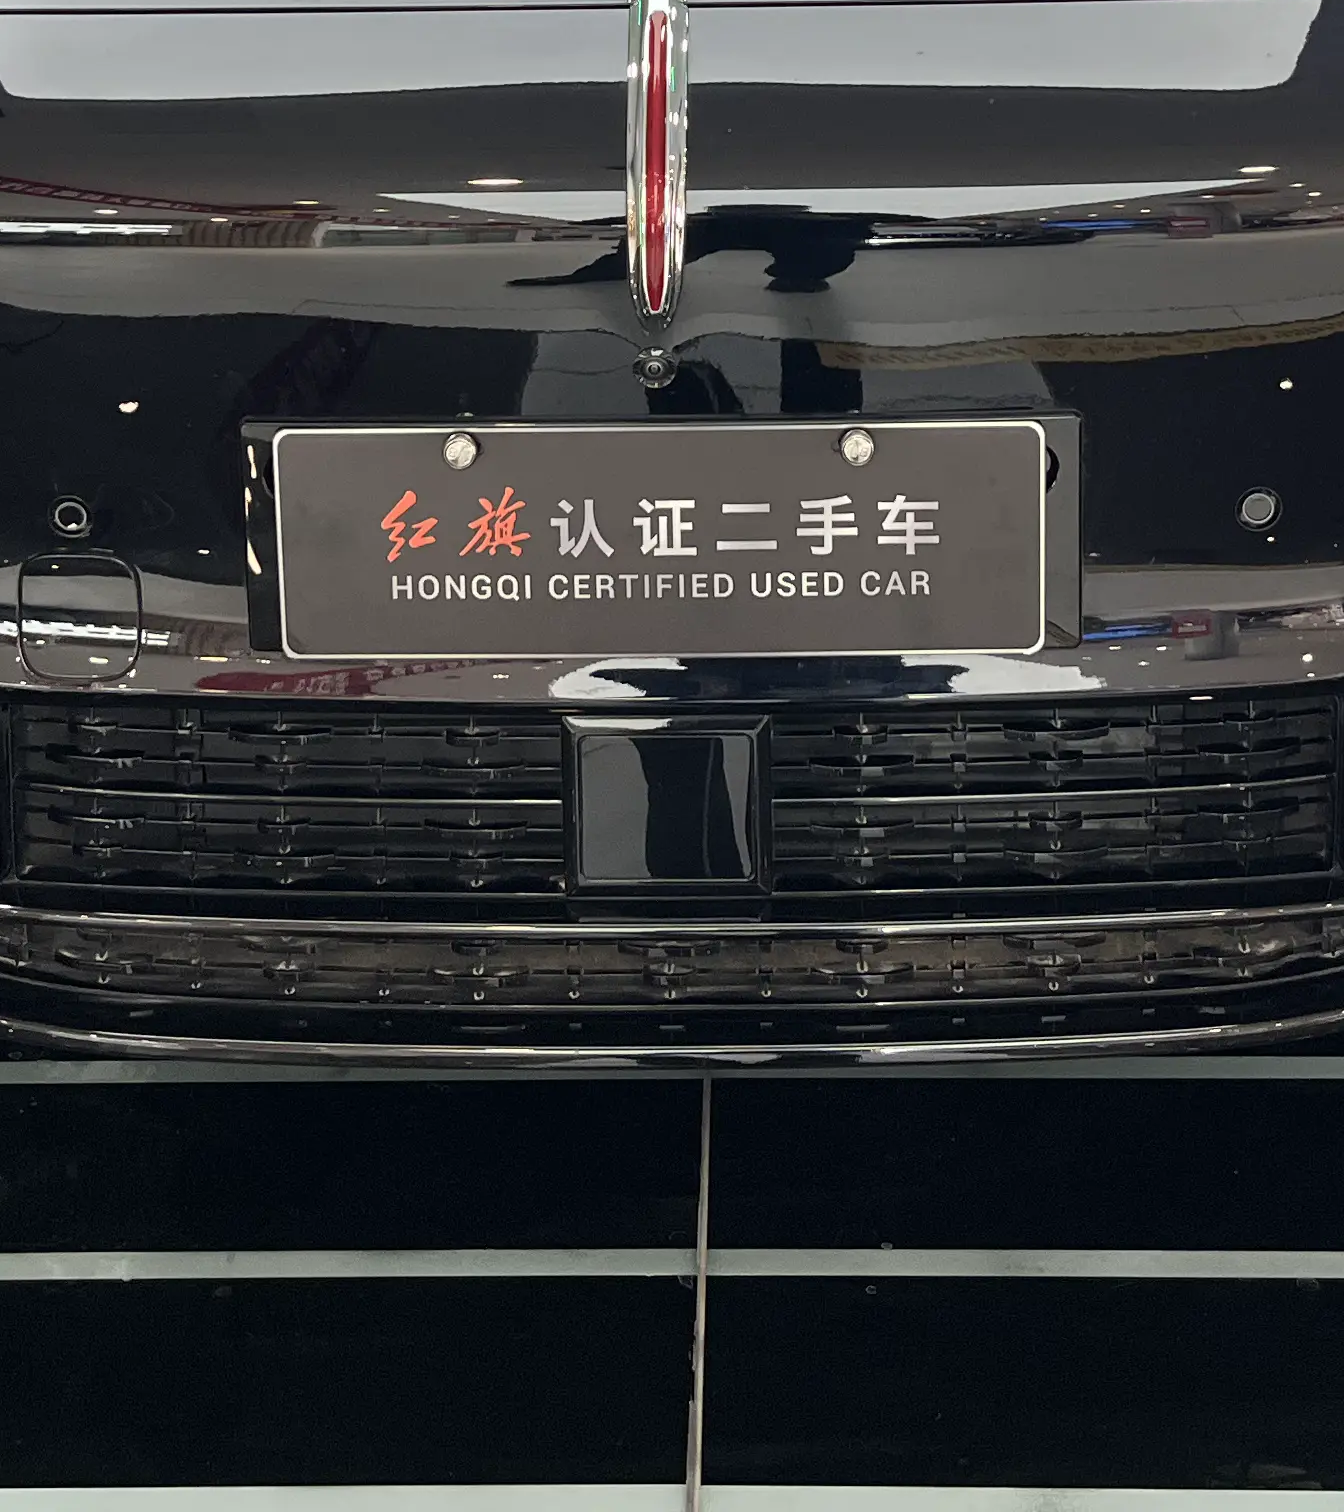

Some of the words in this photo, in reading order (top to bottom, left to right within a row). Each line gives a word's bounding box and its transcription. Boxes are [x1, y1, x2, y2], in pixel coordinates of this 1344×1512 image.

[391, 574, 532, 601] HONGQI
[548, 573, 734, 599] CERTIFIED
[751, 572, 844, 598] USED
[859, 570, 931, 596] CAR
